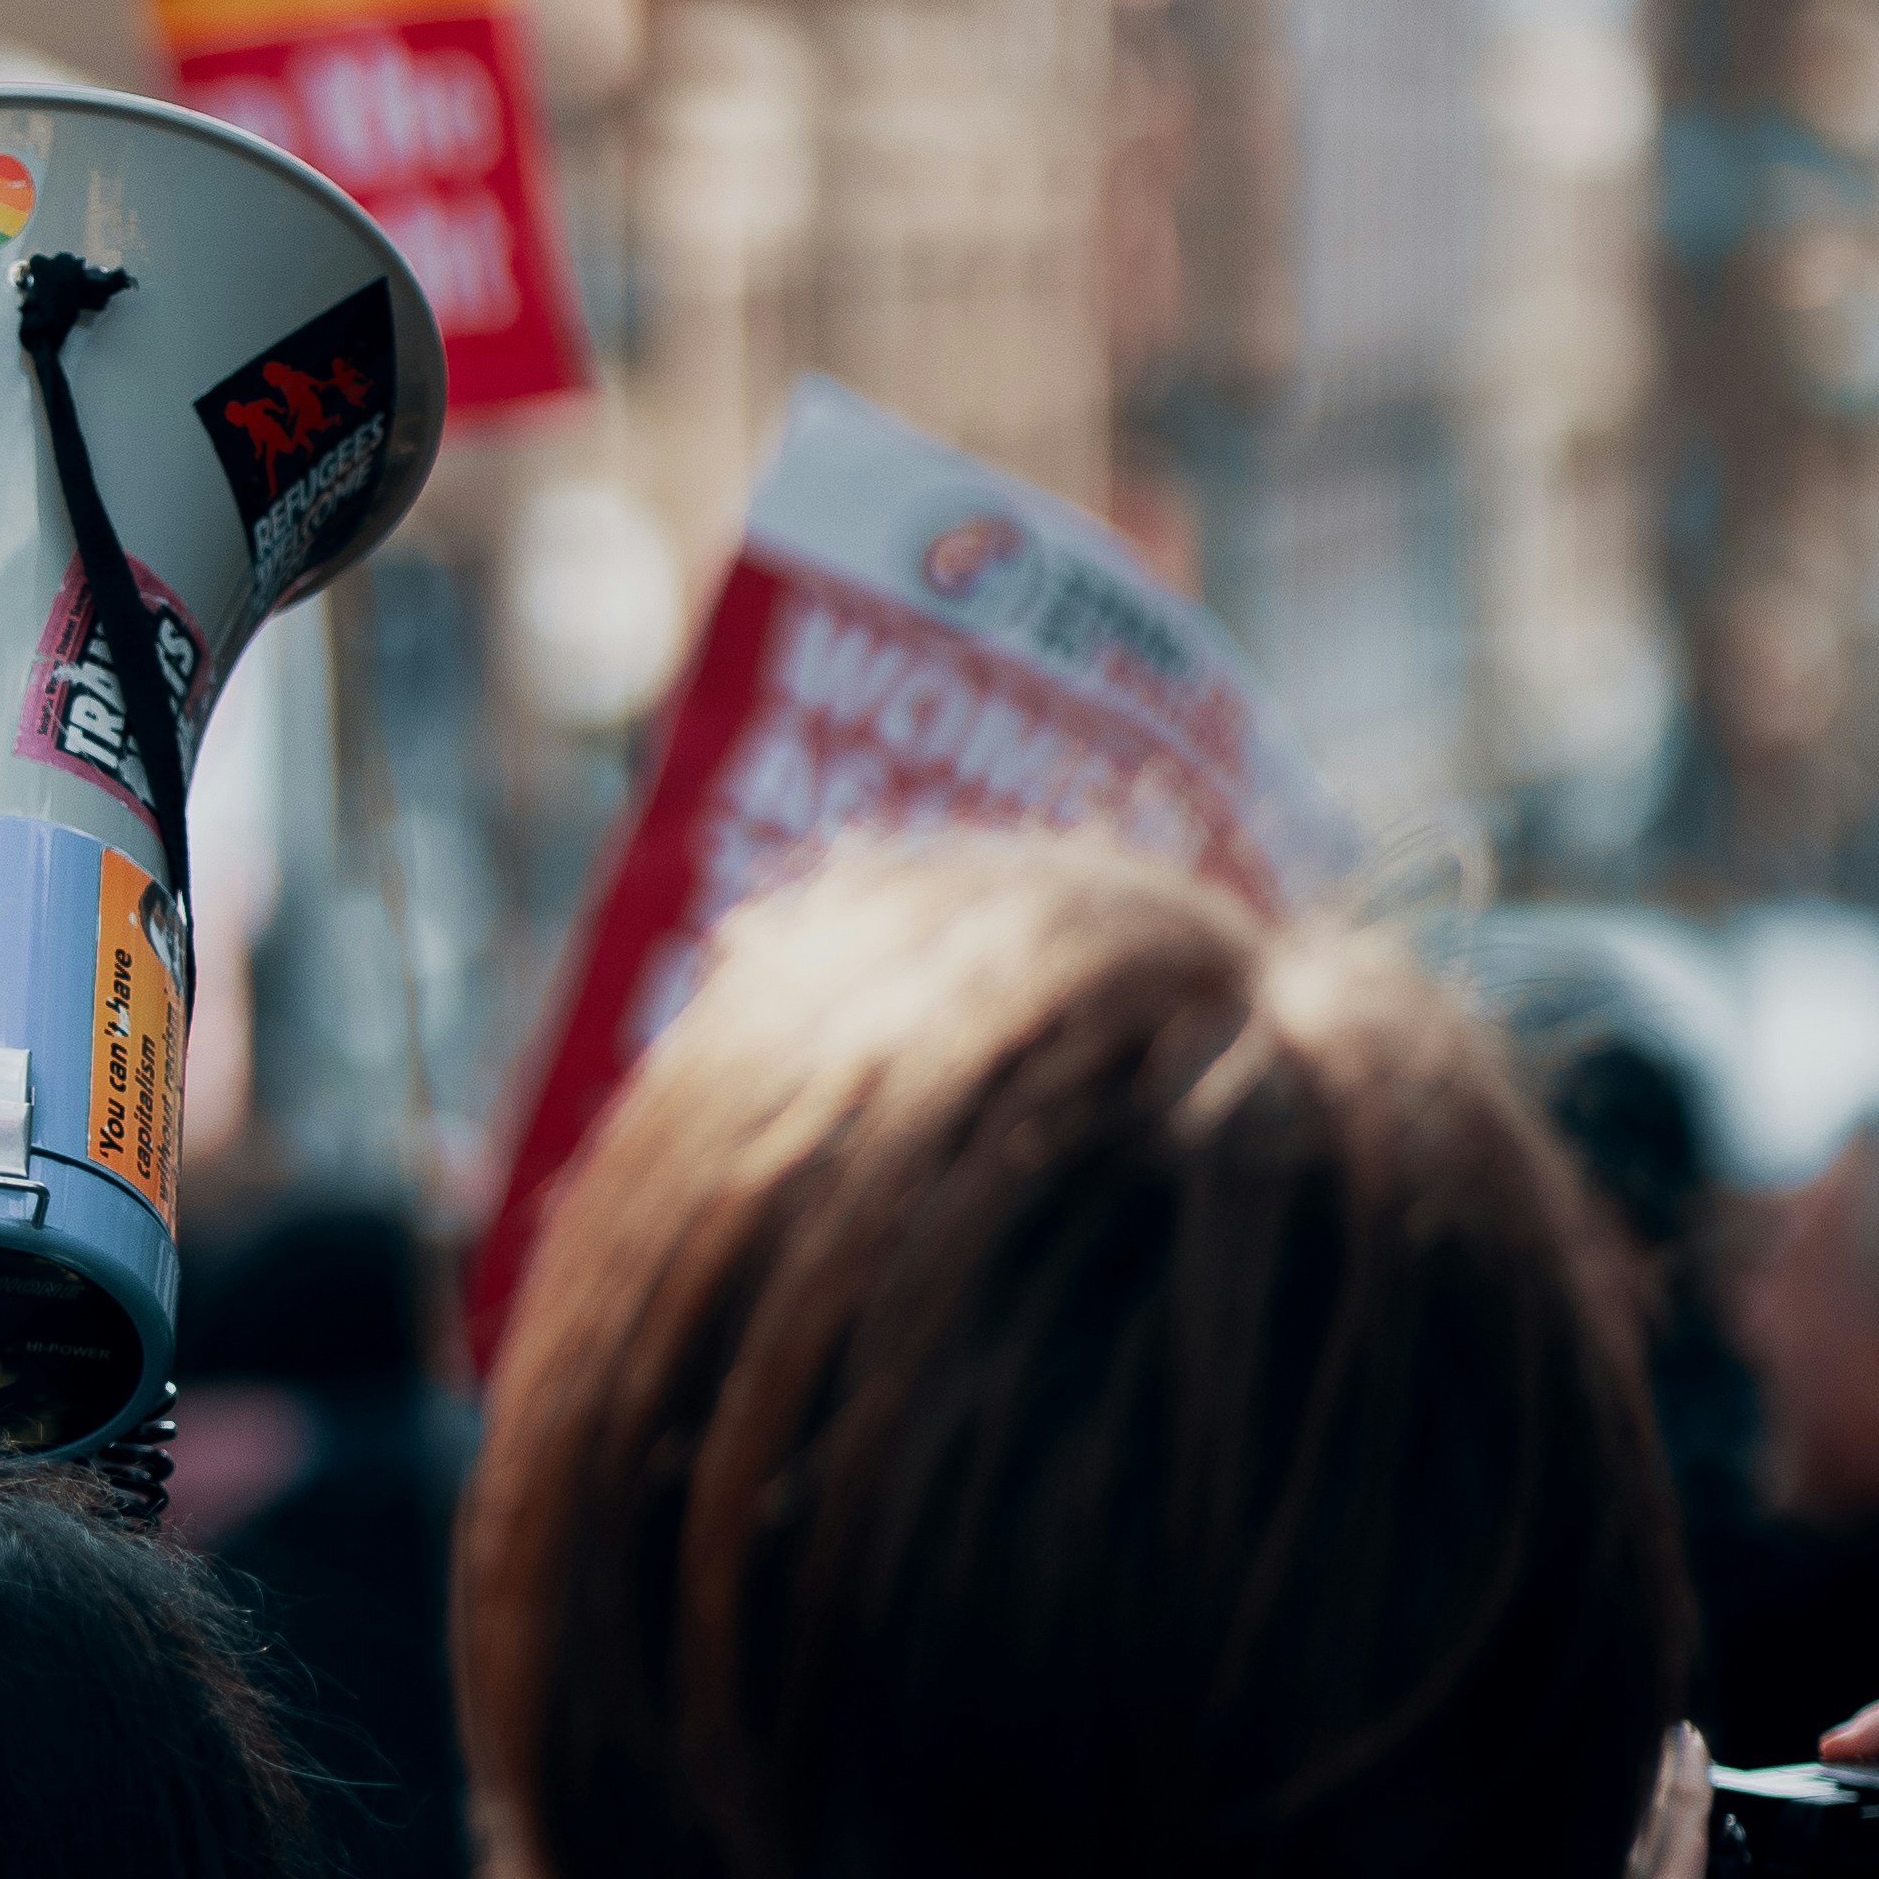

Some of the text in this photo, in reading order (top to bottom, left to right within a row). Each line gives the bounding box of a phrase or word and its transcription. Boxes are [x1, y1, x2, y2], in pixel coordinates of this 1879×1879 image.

[254, 411, 385, 558] REFUGEES
[106, 948, 132, 1015] have
[104, 1020, 129, 1093] can't
[134, 1034, 155, 1180] capitalism
[25, 1340, 113, 1361] HI-POWER
